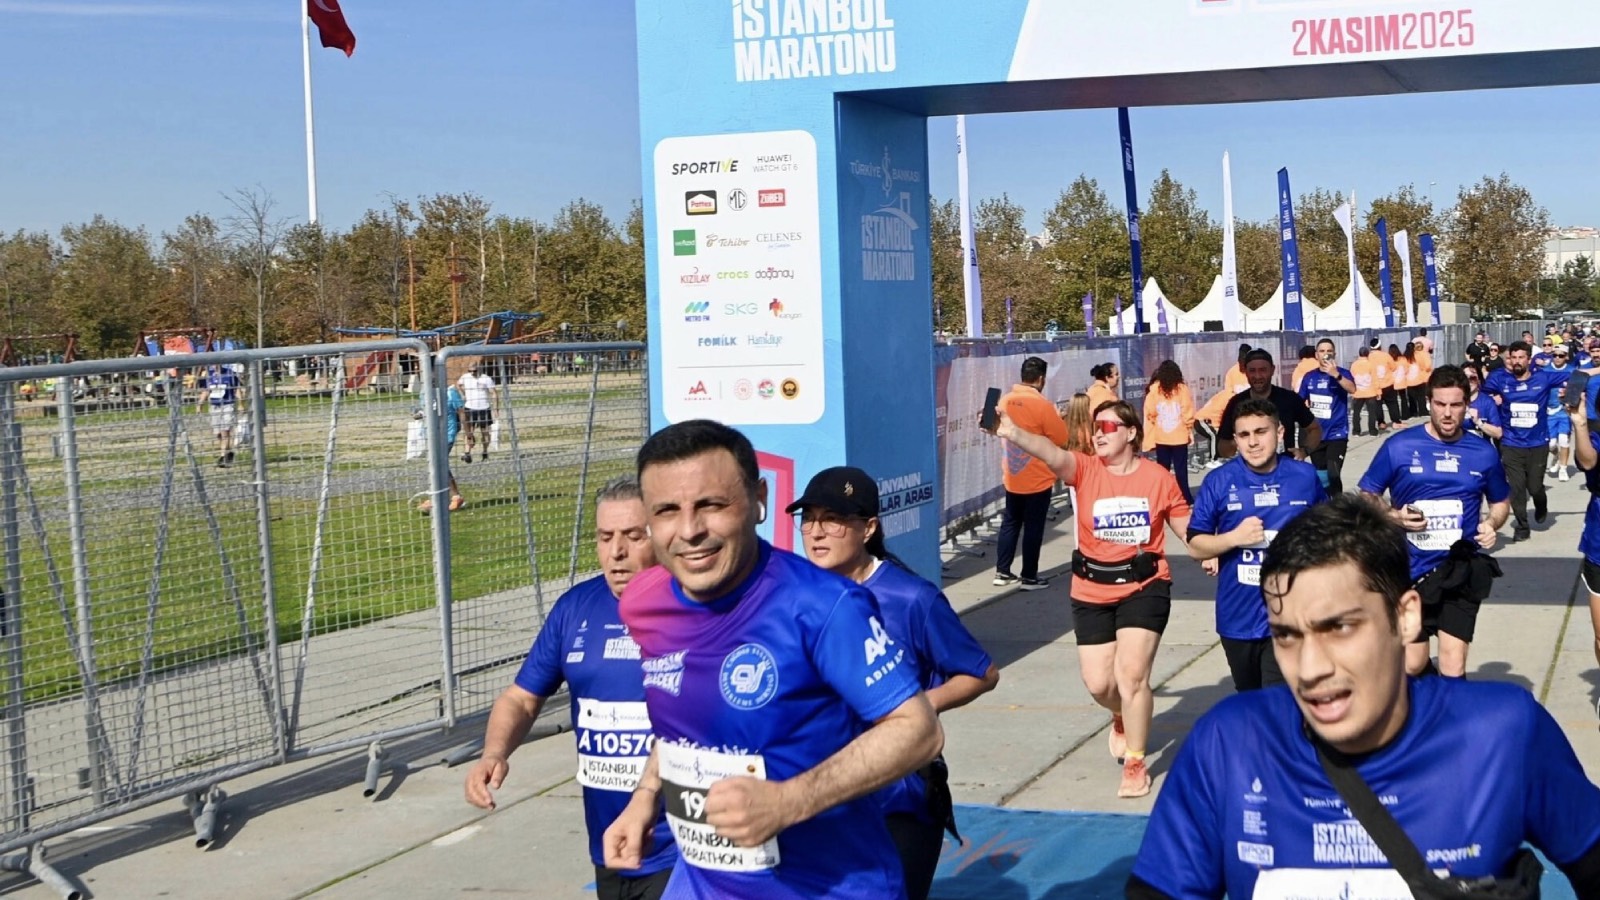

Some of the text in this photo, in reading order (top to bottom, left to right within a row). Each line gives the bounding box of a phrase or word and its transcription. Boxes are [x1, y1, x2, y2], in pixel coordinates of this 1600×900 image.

[734, 31, 896, 82] MARATONU
[757, 154, 792, 163] HUAWEI
[672, 159, 739, 175] SPORTIVE
[753, 165, 777, 173] WATCH
[778, 164, 790, 172] GT
[850, 160, 881, 178] TÜRKİYE
[757, 231, 802, 242] CELENES
[862, 215, 914, 250] İSTANBUL
[718, 238, 751, 248] Tchibo
[862, 250, 915, 281] MARATONU
[717, 270, 749, 280] crocs
[724, 303, 758, 316] SKG
[905, 486, 934, 507] ARASI
[1098, 513, 1147, 528] A 11204
[1243, 549, 1254, 562] D
[579, 730, 591, 752] A
[588, 760, 640, 775] ISTANBUL
[680, 790, 707, 819] 19
